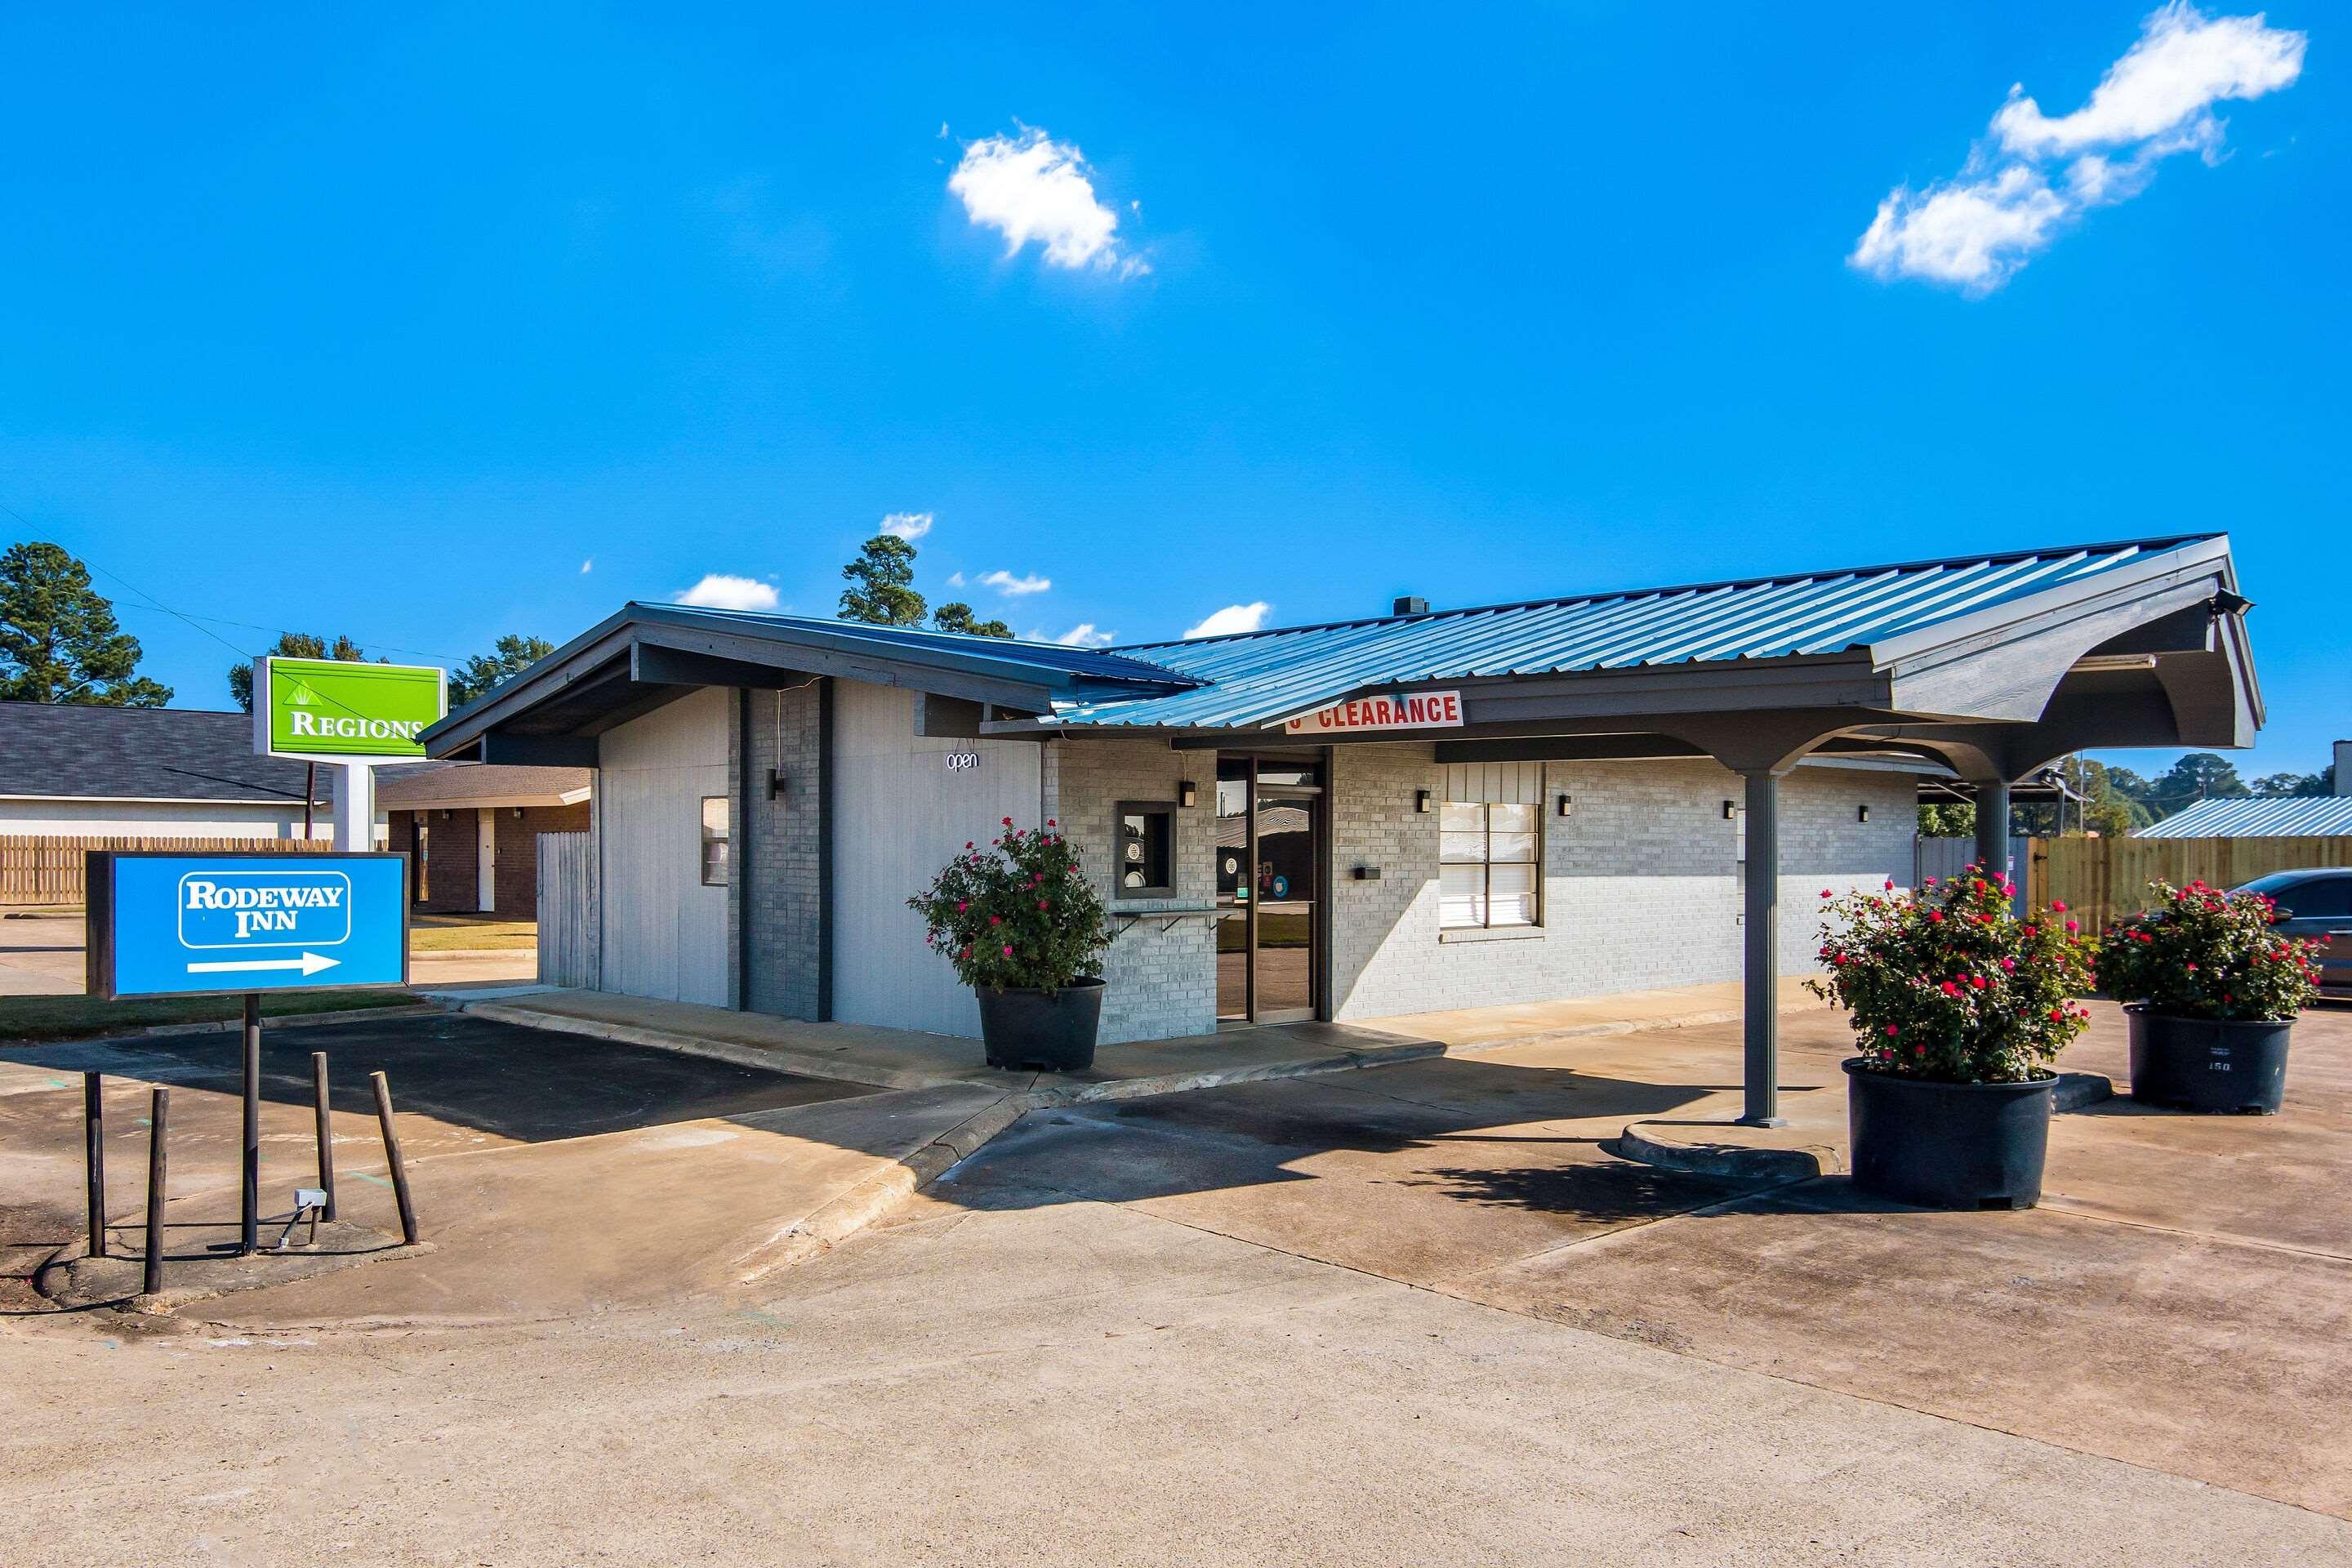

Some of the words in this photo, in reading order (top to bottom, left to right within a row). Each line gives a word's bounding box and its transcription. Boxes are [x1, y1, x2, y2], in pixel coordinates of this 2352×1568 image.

[291, 711, 424, 739] REGIONS
[1318, 697, 1458, 728] CLEARANCE
[947, 753, 978, 773] open
[186, 881, 344, 910] RODEWAY
[234, 910, 298, 938] INN
